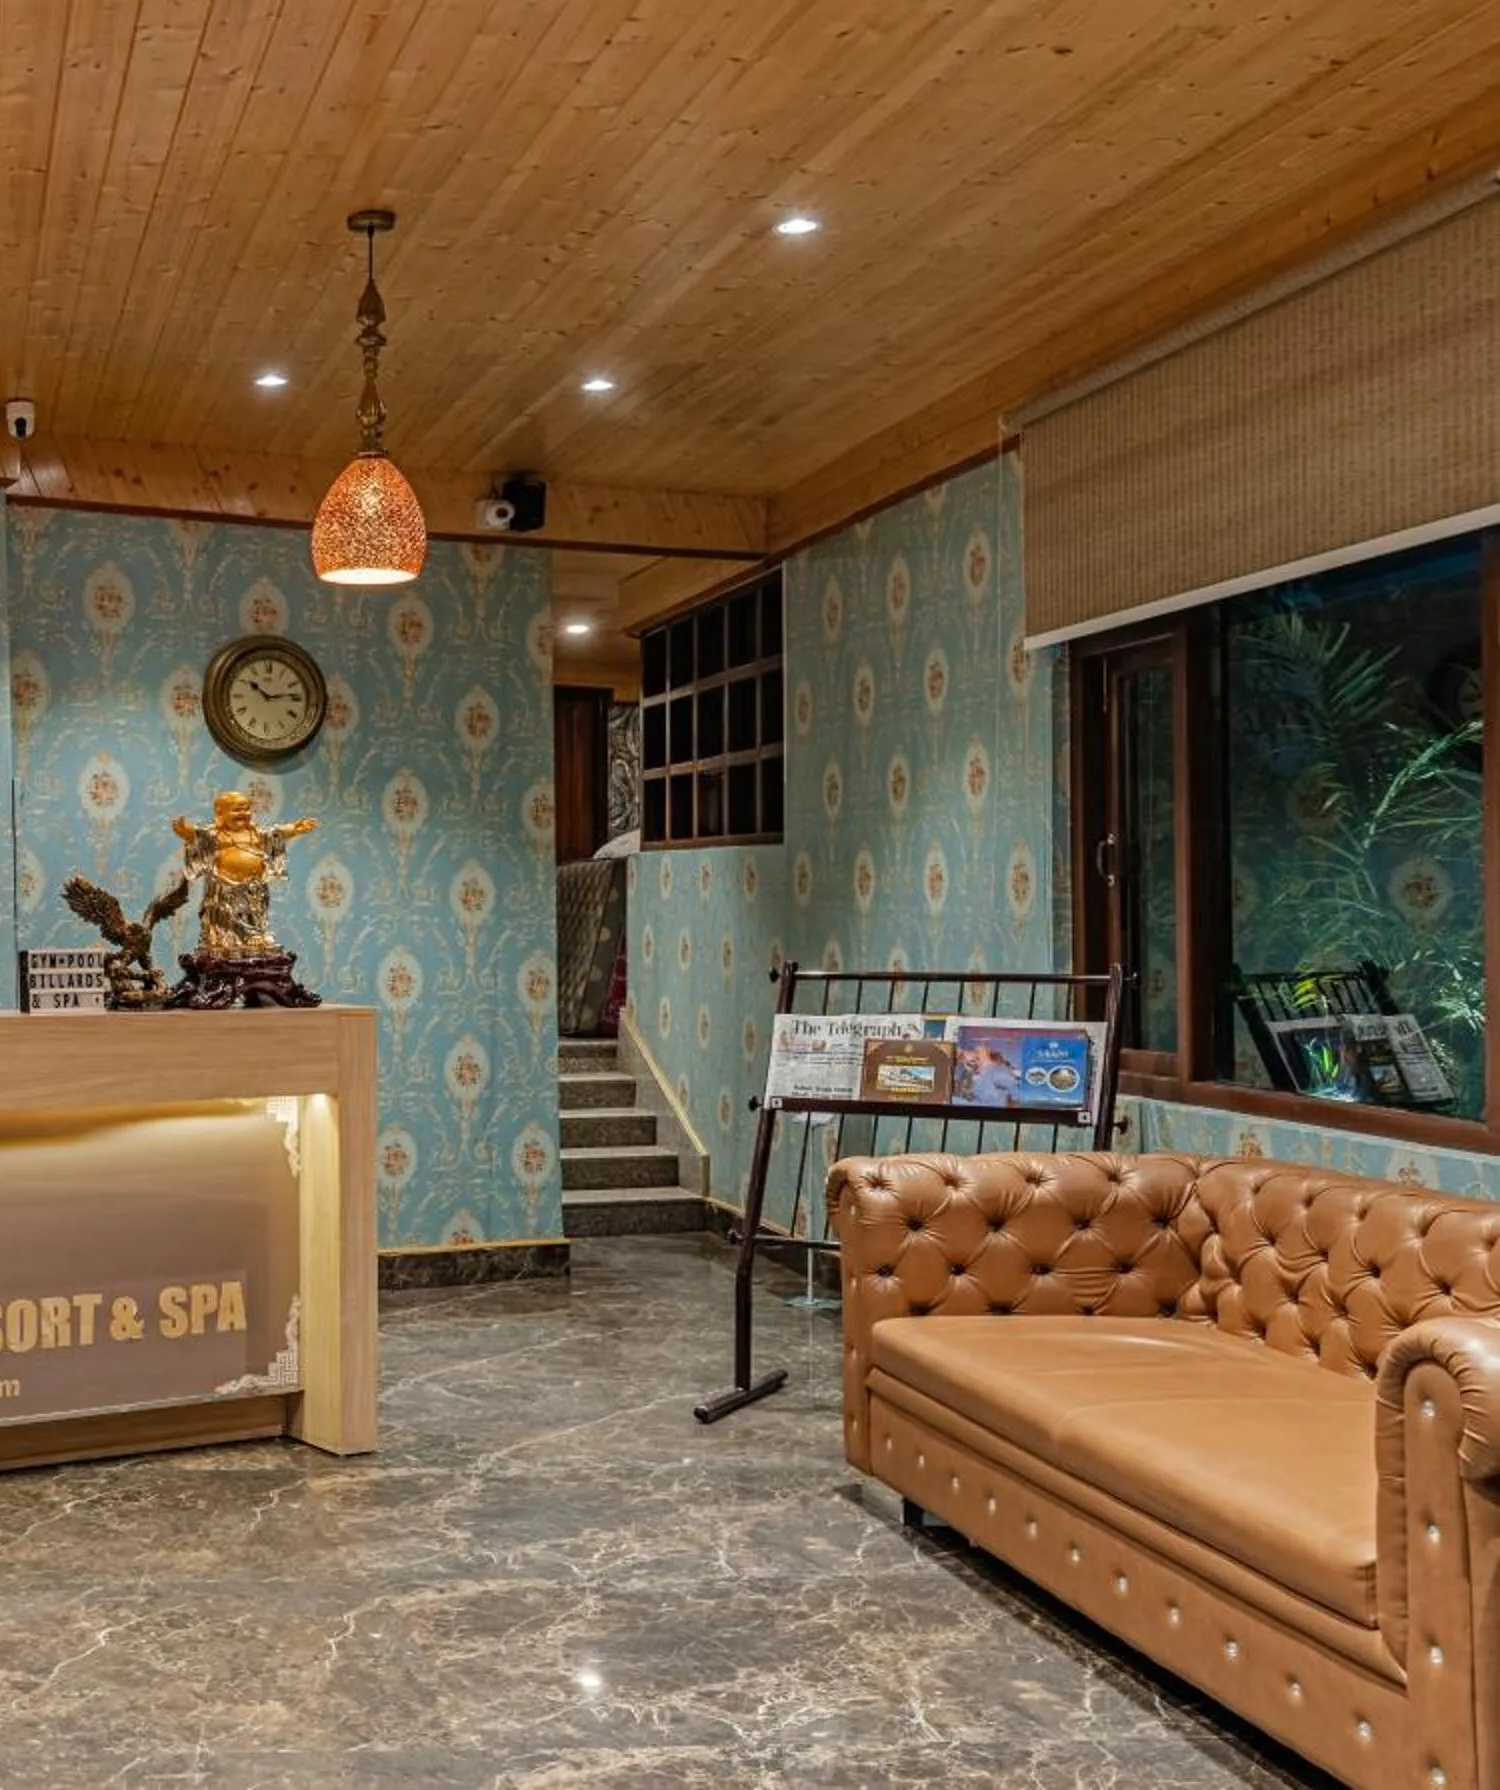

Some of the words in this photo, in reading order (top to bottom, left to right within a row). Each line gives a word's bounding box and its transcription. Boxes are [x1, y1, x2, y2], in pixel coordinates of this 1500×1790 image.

[32, 995, 41, 1008] &
[53, 994, 80, 1008] SPA
[792, 1019, 821, 1036] The
[827, 1019, 902, 1038] Telegraph
[109, 1296, 145, 1341] &
[158, 1281, 248, 1339] SPA
